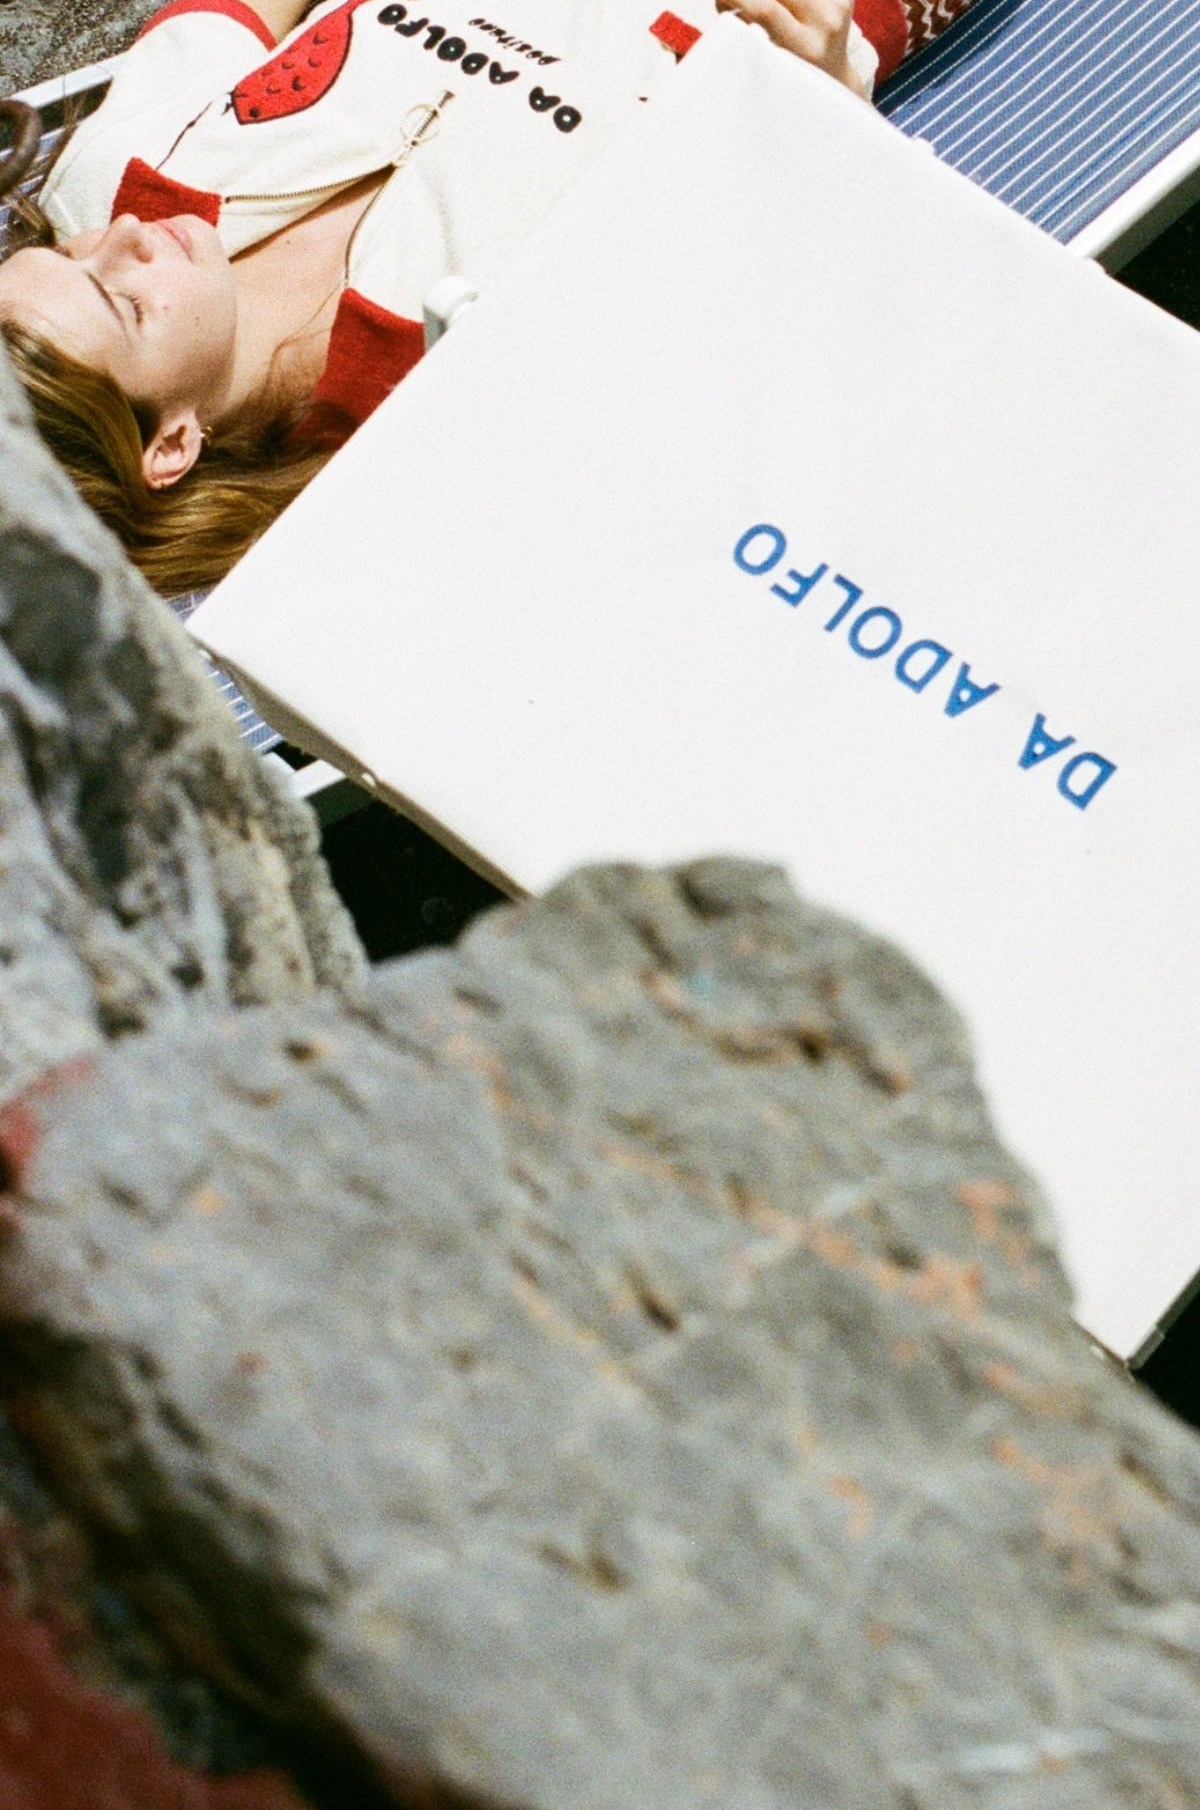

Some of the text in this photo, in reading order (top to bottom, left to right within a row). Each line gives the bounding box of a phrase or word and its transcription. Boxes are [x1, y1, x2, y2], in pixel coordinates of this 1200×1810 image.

[377, 3, 582, 134] DA ADOLFO
[732, 523, 1117, 811] DA ADOLFO
